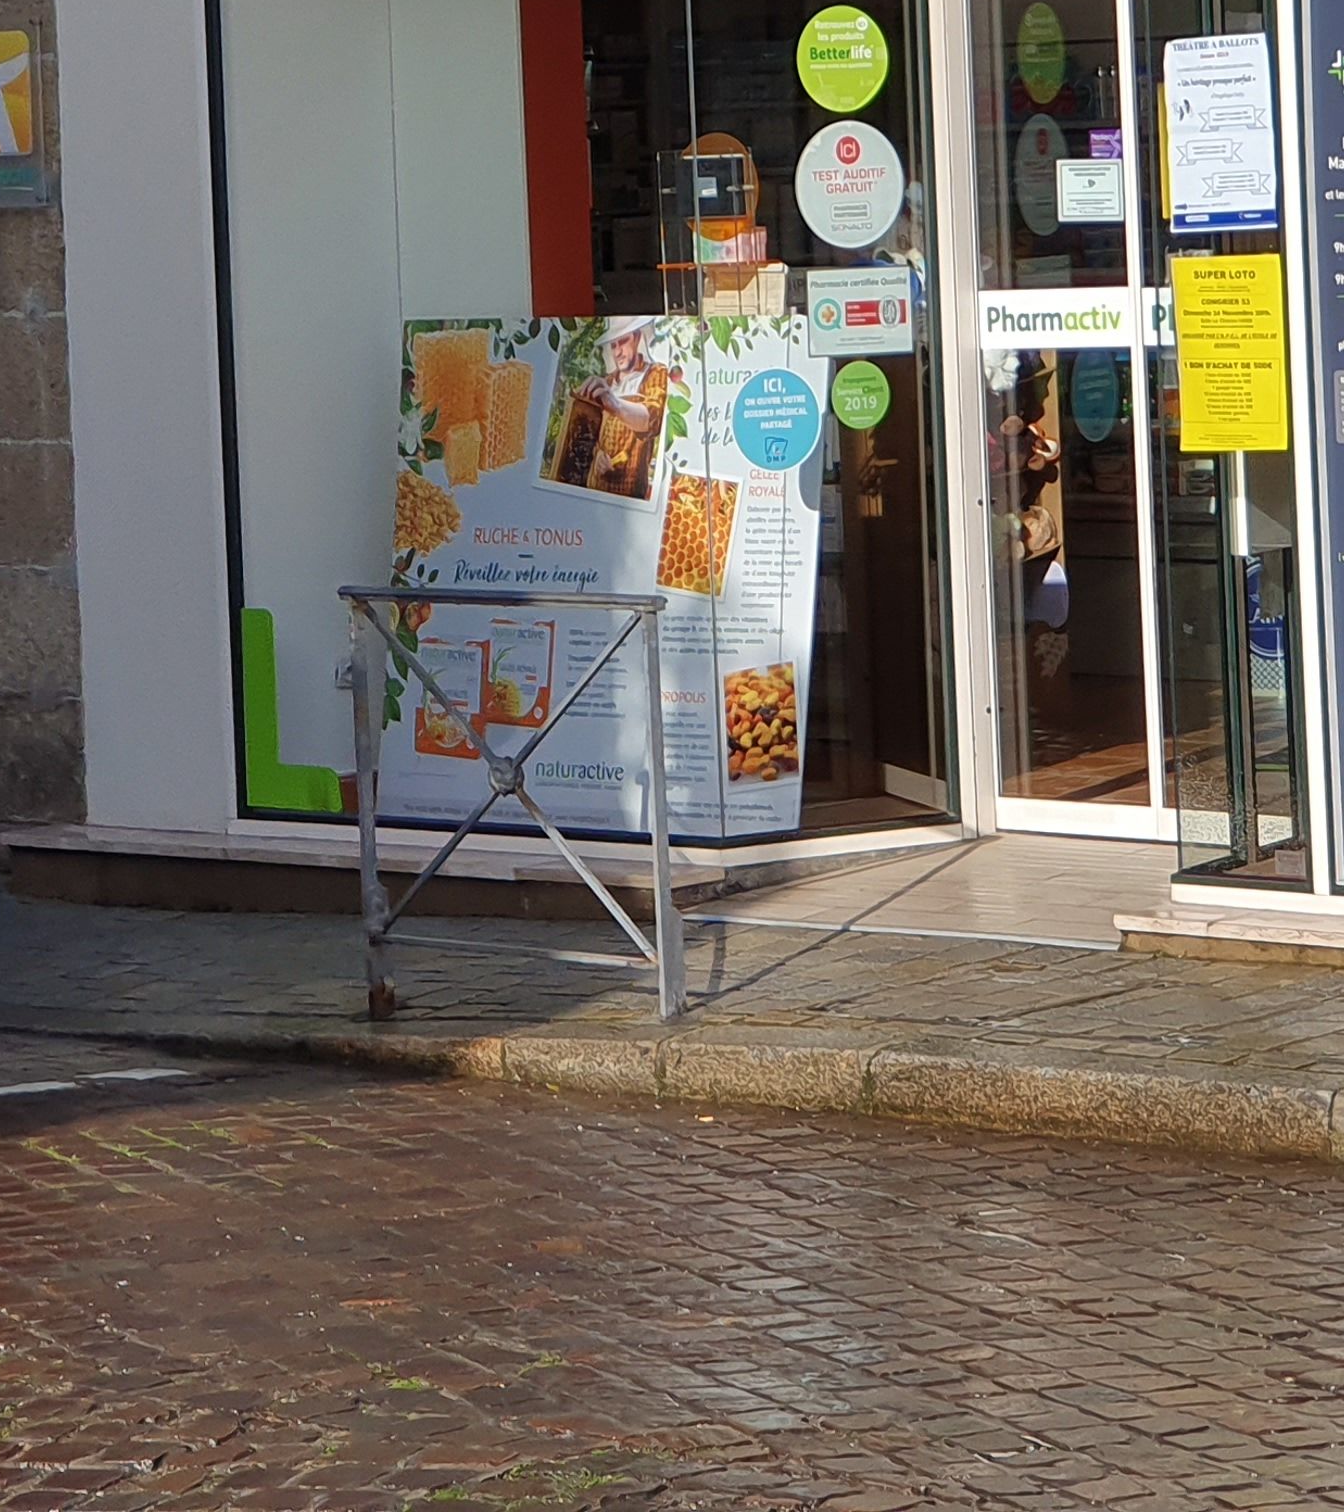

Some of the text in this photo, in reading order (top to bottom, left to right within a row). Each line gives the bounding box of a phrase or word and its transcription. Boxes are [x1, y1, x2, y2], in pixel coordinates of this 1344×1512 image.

[810, 45, 872, 60] Betterlife
[812, 168, 886, 181] TEST AUDITIF
[1325, 190, 1334, 200] et
[1193, 270, 1256, 279] SUPER LOTO
[987, 304, 1121, 332] Pharmactiv
[763, 378, 786, 393] ICI,
[783, 395, 806, 404] VOTRE
[845, 396, 877, 411] 2019
[473, 527, 519, 544] RUCHE
[535, 529, 584, 546] TONUS
[454, 559, 600, 593] Réveillez votre énergie
[535, 761, 624, 781] naturactive
